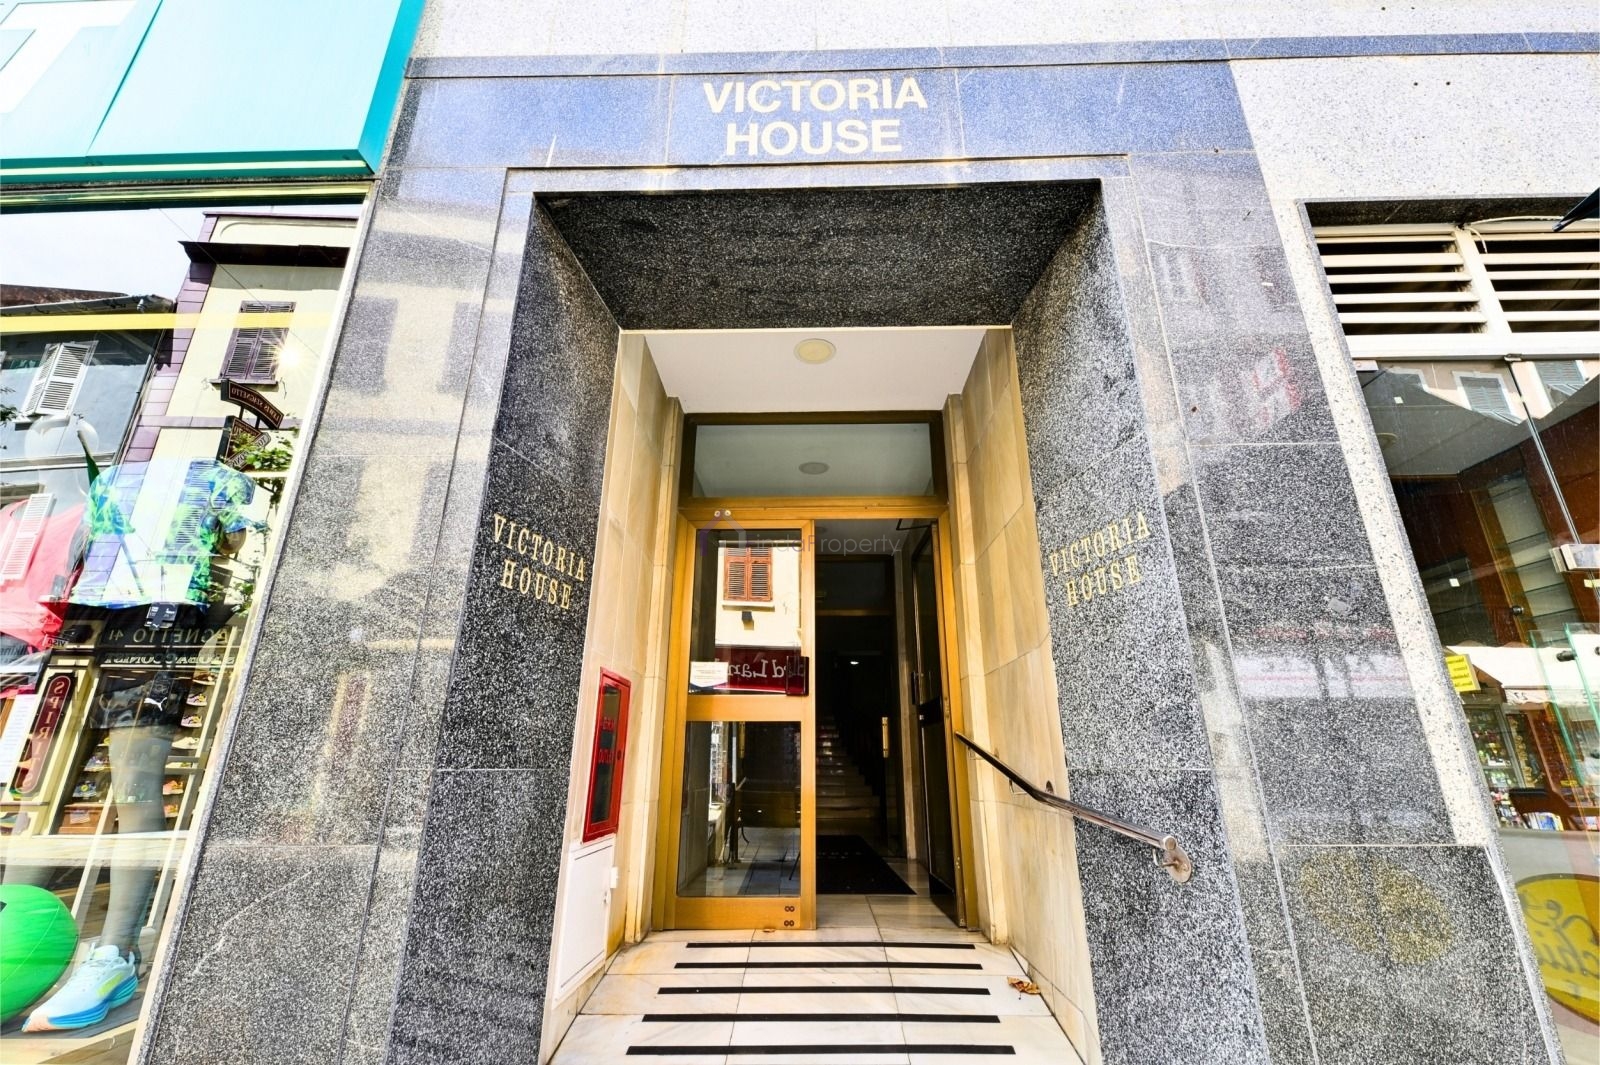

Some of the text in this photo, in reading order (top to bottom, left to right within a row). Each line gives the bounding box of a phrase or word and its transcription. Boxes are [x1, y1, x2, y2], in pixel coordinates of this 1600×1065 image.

[703, 77, 928, 113] VICTORIA
[726, 120, 902, 156] HOUSE
[494, 513, 584, 581] VICTORIA
[1049, 512, 1151, 577] VICTORIA
[500, 559, 571, 609] HOUSE
[1066, 555, 1142, 606] HOUSE
